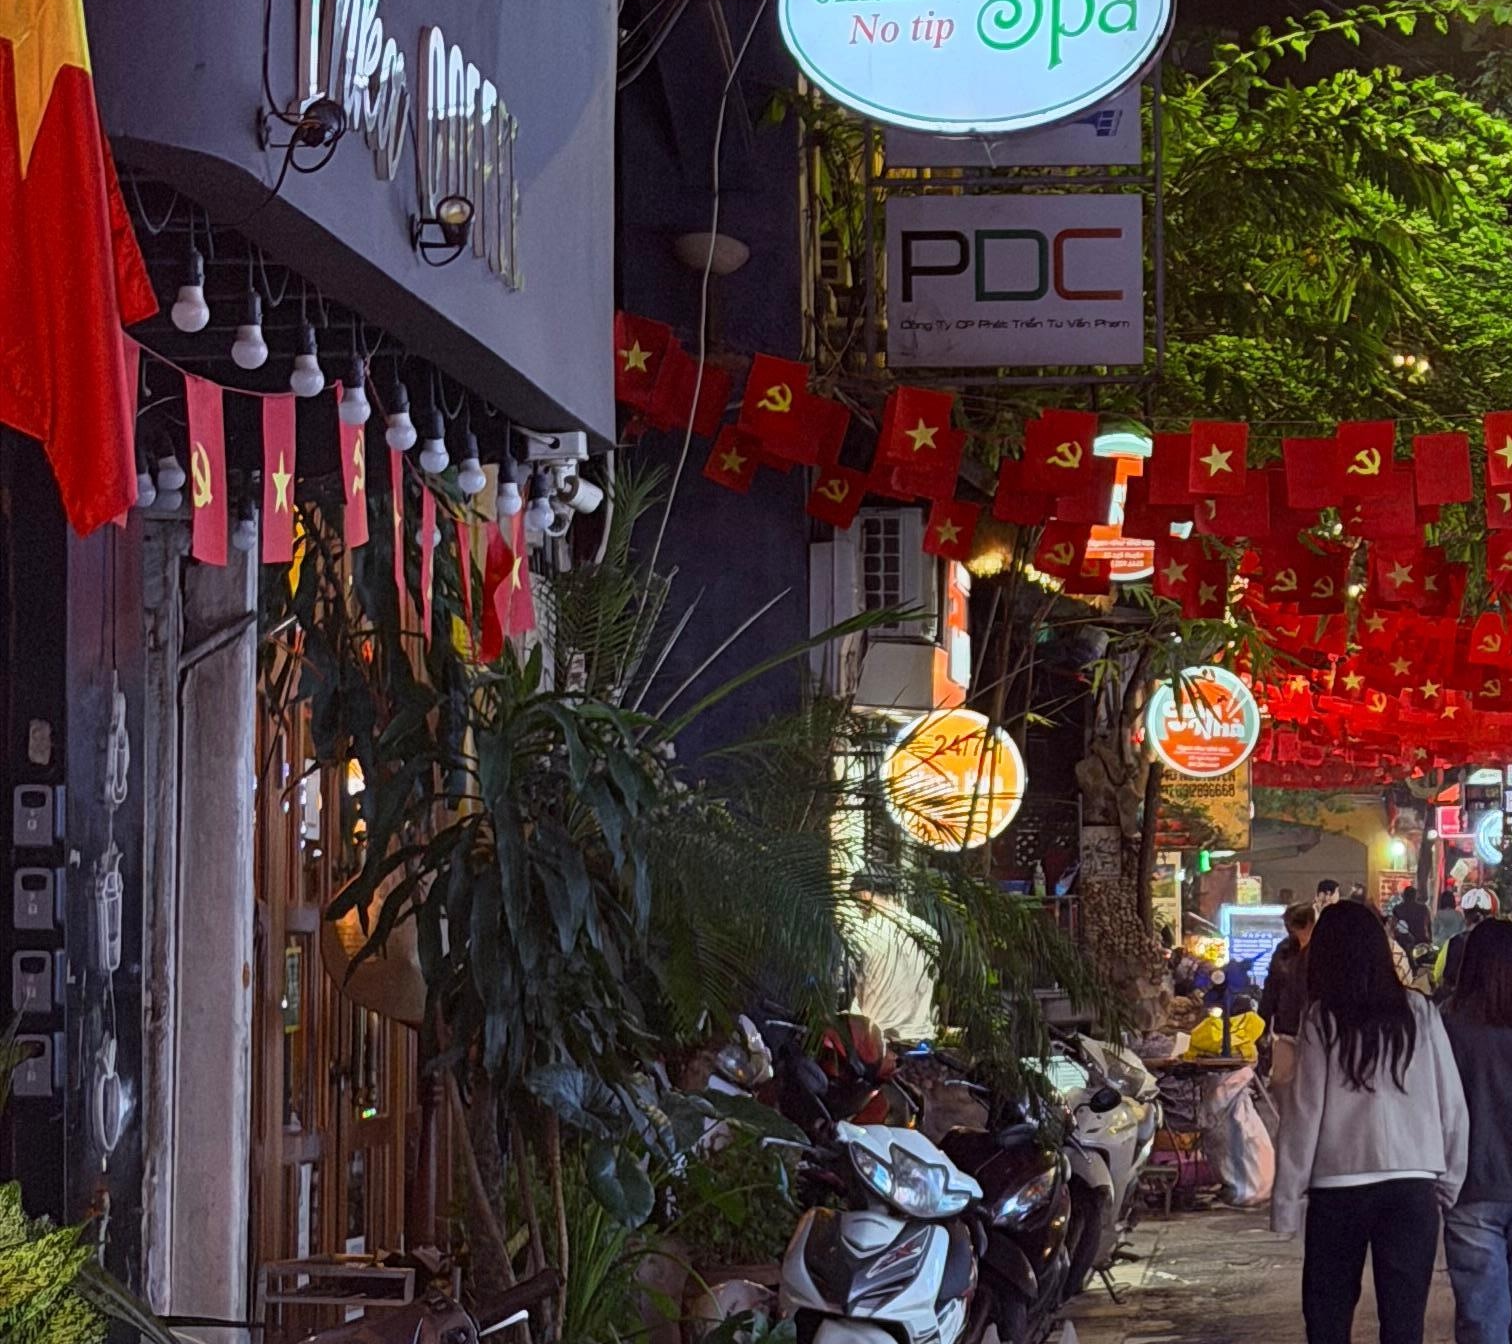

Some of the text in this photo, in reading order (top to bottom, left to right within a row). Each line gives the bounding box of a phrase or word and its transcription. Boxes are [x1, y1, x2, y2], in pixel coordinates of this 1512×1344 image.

[848, 11, 955, 48] No tip
[901, 228, 1124, 304] PDC
